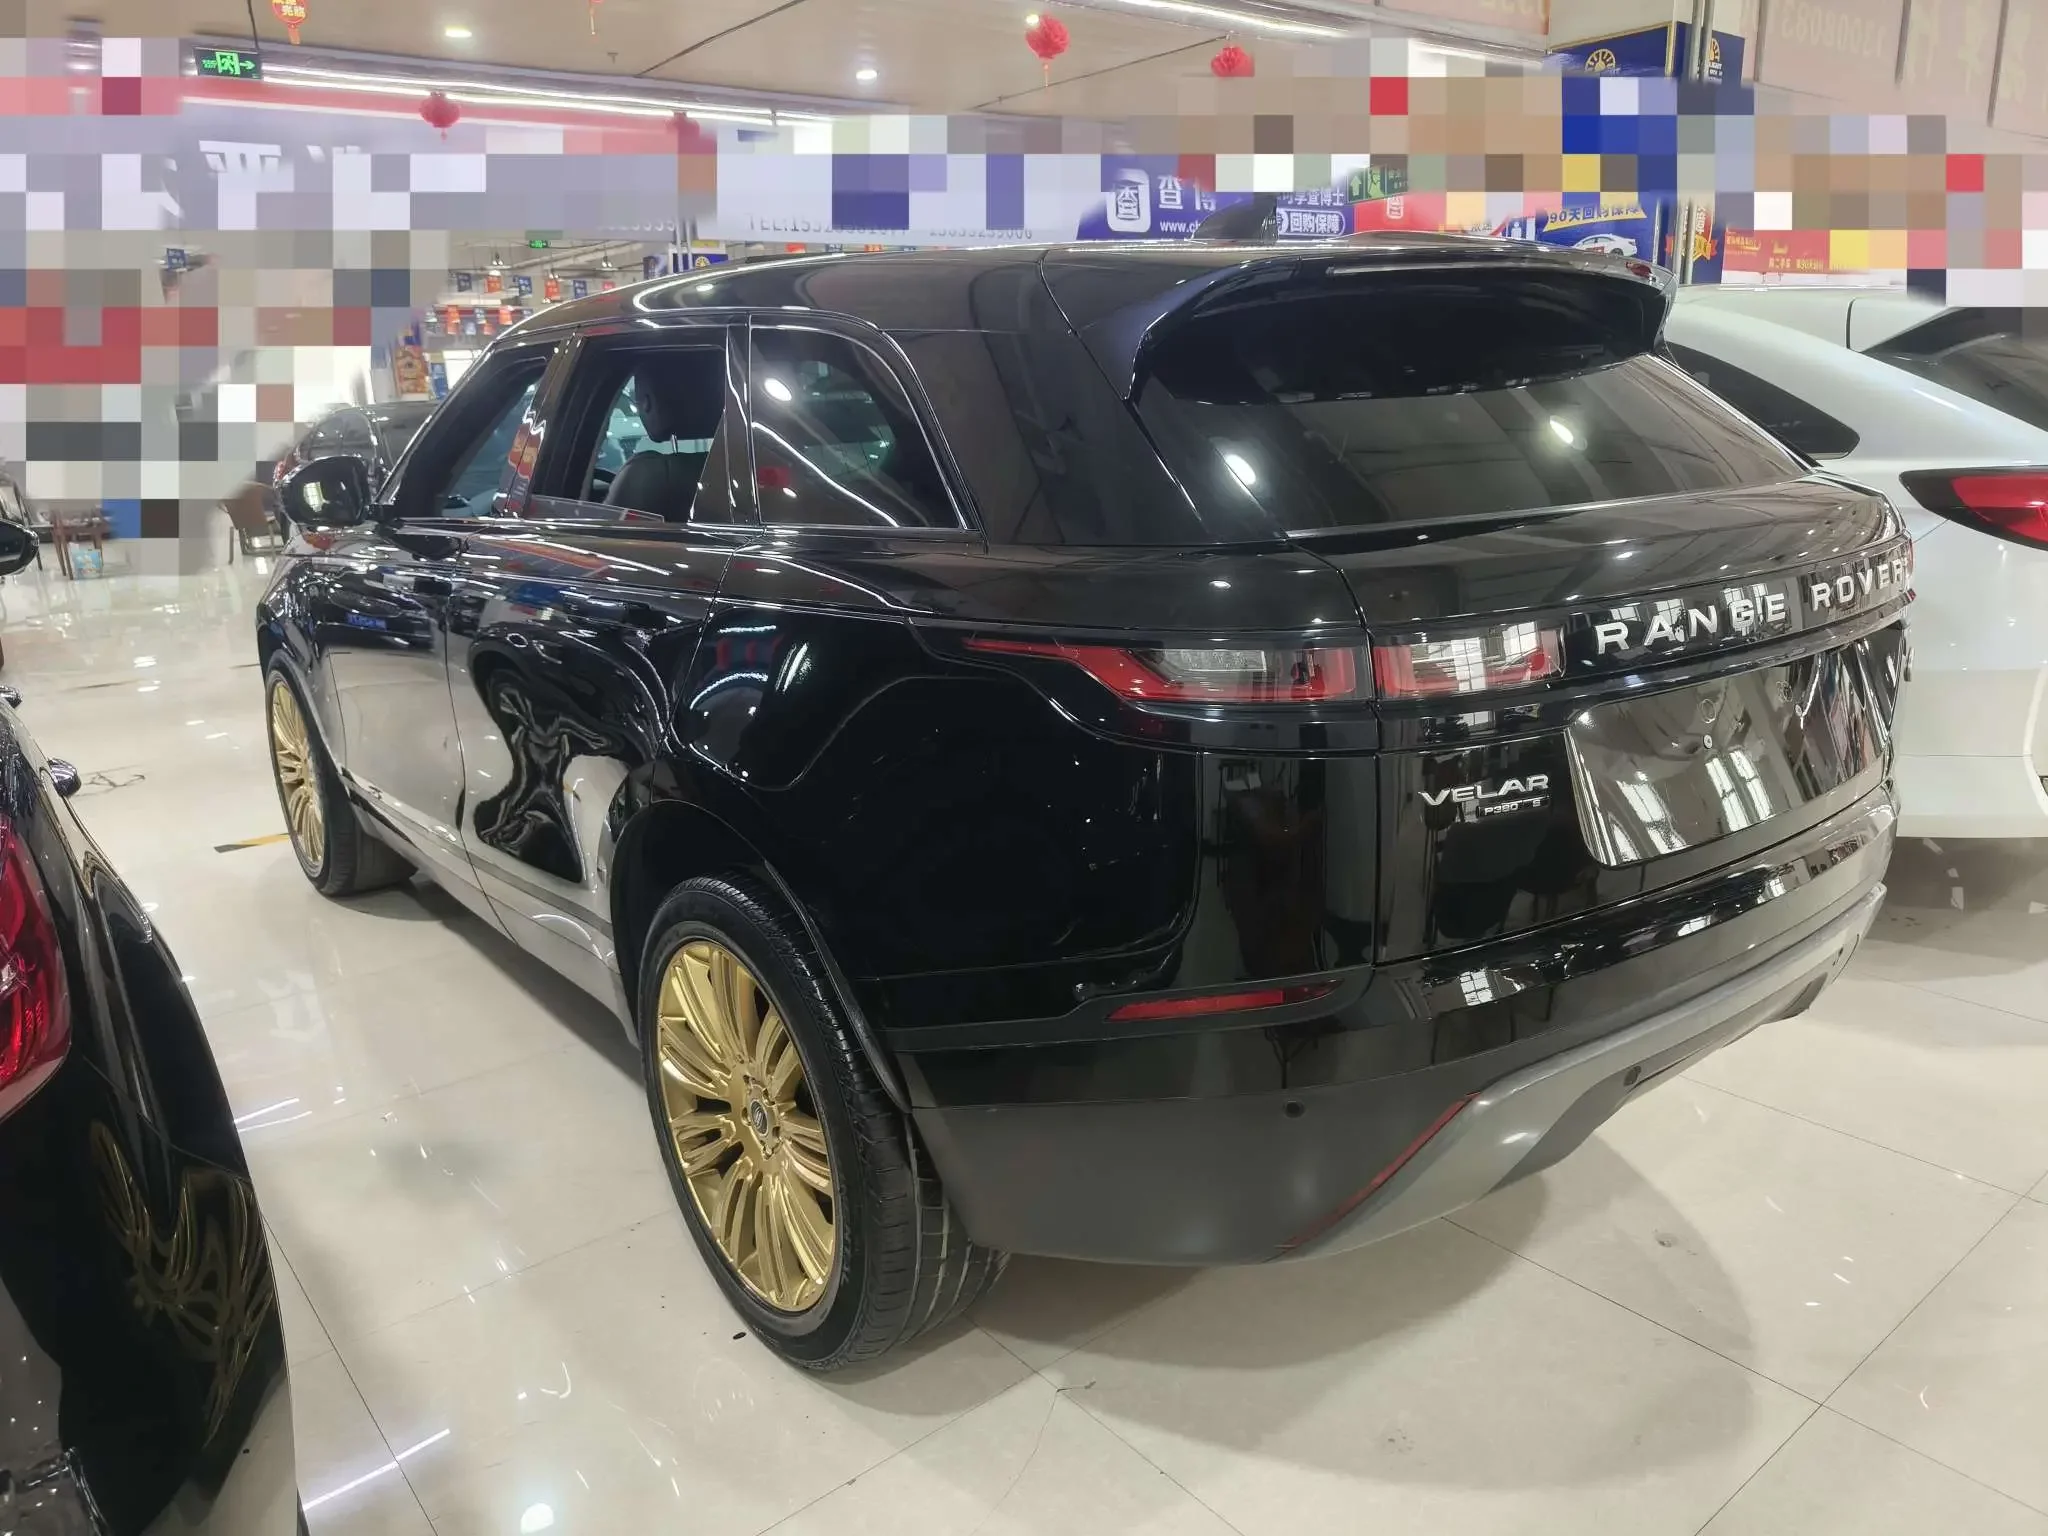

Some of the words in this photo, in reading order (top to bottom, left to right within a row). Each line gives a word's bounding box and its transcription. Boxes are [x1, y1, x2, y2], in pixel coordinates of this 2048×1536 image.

[1290, 212, 1340, 233] 回购保障
[1595, 593, 1786, 655] RANGE
[1810, 558, 1908, 612] ROVER
[1418, 774, 1549, 806] VELAR
